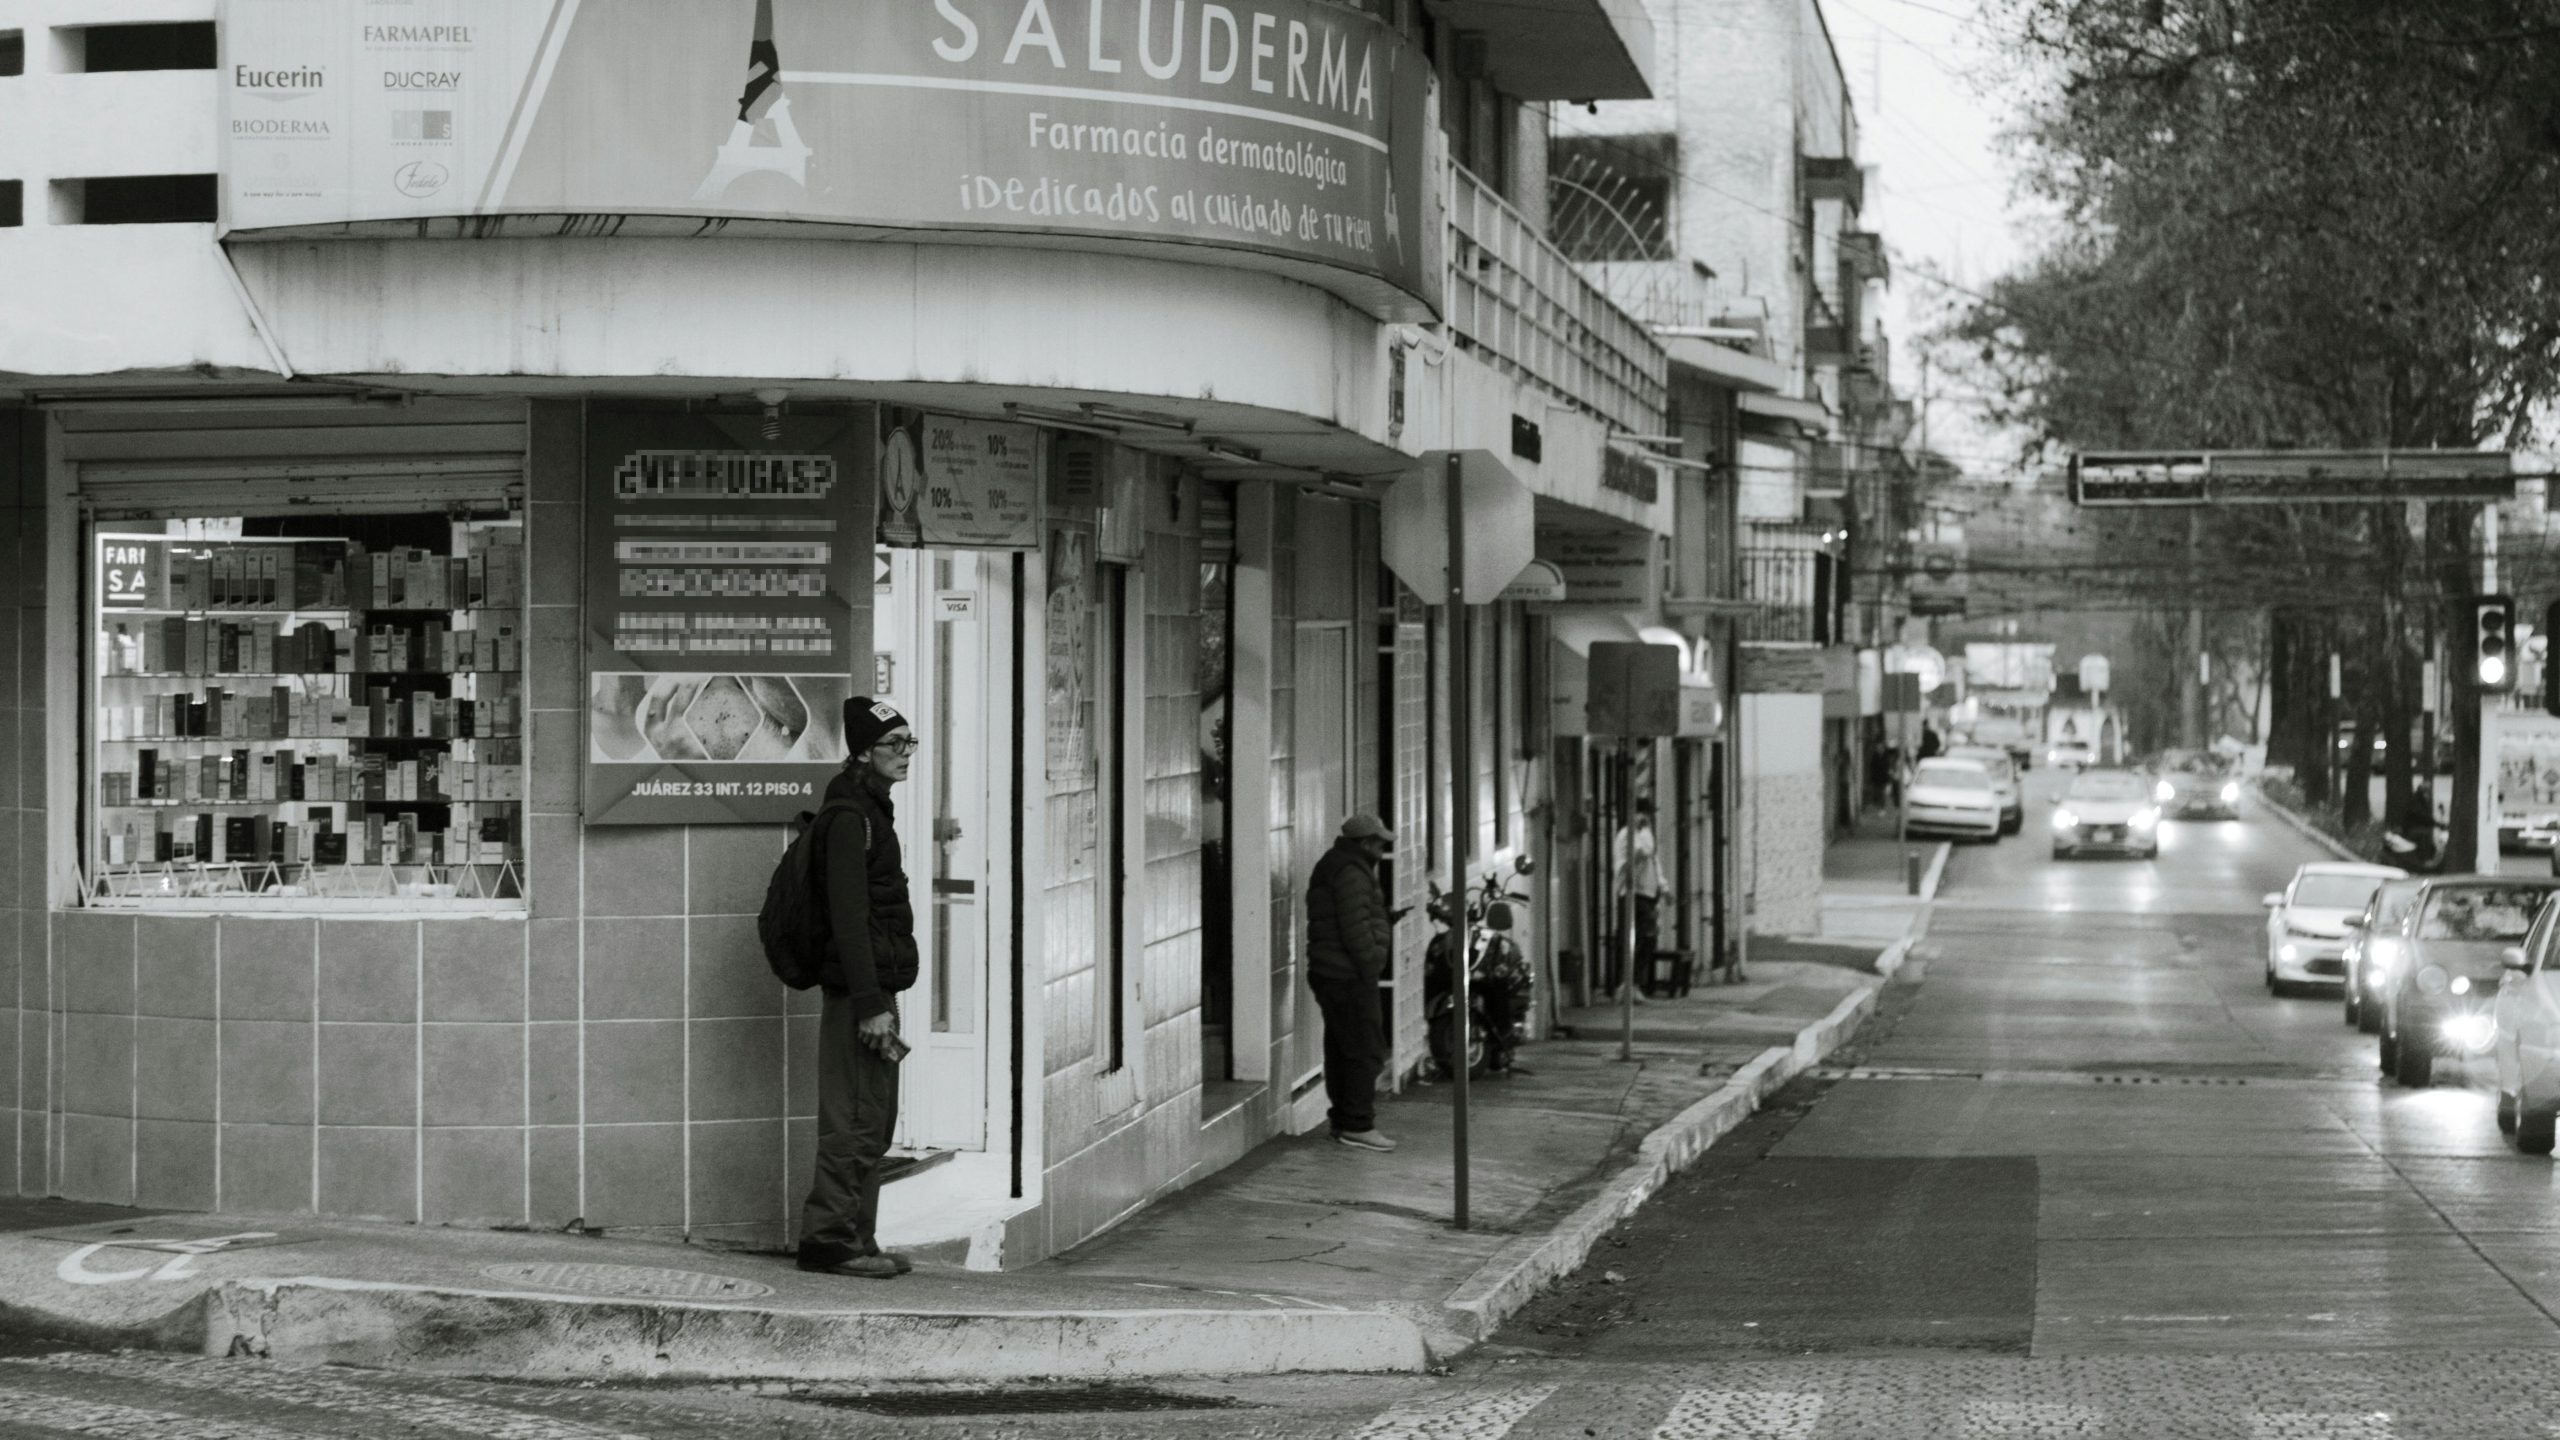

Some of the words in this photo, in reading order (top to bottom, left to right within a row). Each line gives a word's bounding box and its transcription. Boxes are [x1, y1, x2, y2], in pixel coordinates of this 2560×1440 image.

[364, 25, 472, 42] FARMAPIEL
[932, 0, 1374, 121] SALUDERMA
[236, 64, 323, 88] Eucerin
[384, 72, 461, 88] DUCRAY
[232, 119, 330, 134] BIODERMA
[1028, 111, 1187, 160] Farmacia
[1198, 126, 1347, 190] dermatológica
[1171, 190, 1196, 225] al
[1204, 193, 1291, 237] cuidado
[1298, 204, 1319, 241] de
[931, 428, 954, 451] 20%
[987, 434, 1008, 457] 10%
[930, 487, 952, 509] 10%
[987, 488, 1008, 510] 10%
[105, 546, 146, 564] FAR
[946, 602, 968, 612] VISA
[631, 778, 691, 796] JUÁREZ
[694, 783, 714, 796] 33
[716, 783, 744, 796] INT.
[746, 783, 763, 796] 12
[765, 783, 799, 796] PISO
[802, 783, 812, 796] 4
